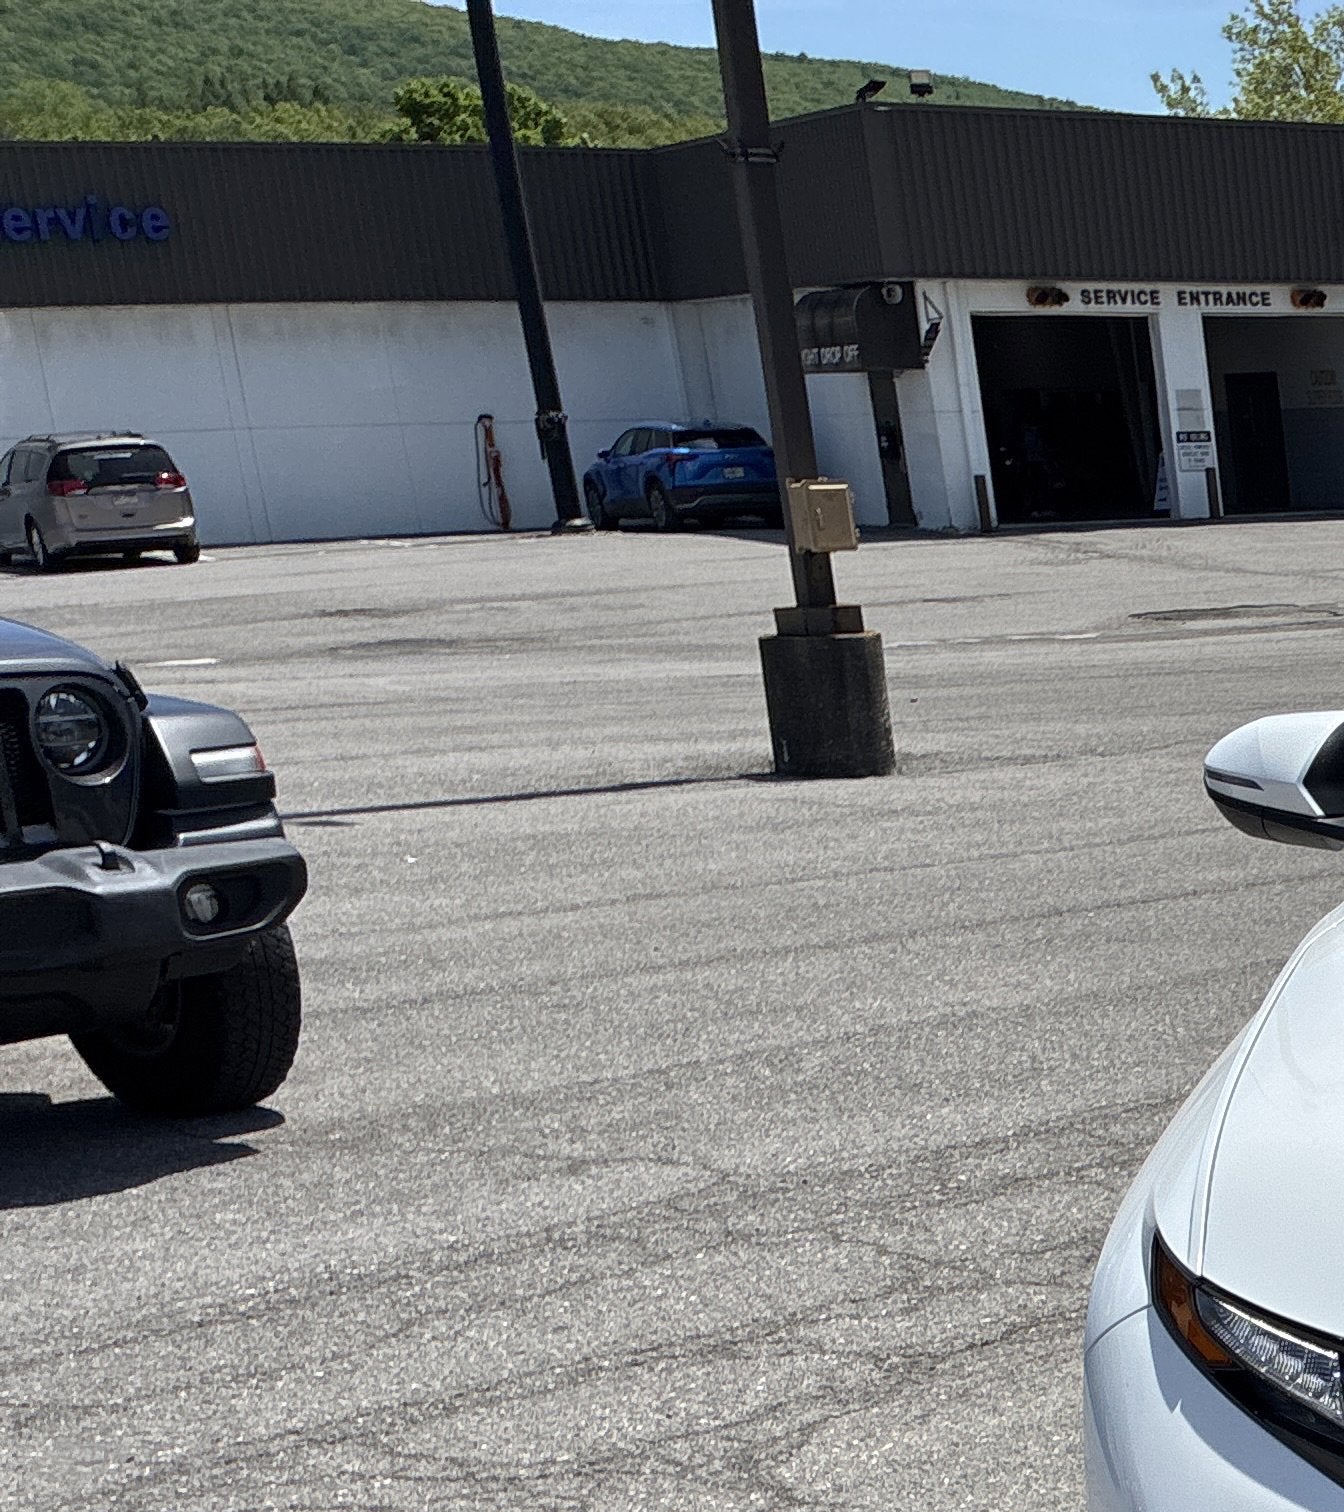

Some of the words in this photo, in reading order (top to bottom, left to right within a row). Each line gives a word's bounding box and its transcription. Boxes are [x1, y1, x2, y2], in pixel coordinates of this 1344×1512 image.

[1, 194, 171, 241] ervice
[1080, 288, 1161, 306] SERVICE
[1176, 290, 1272, 307] ENTRANCE
